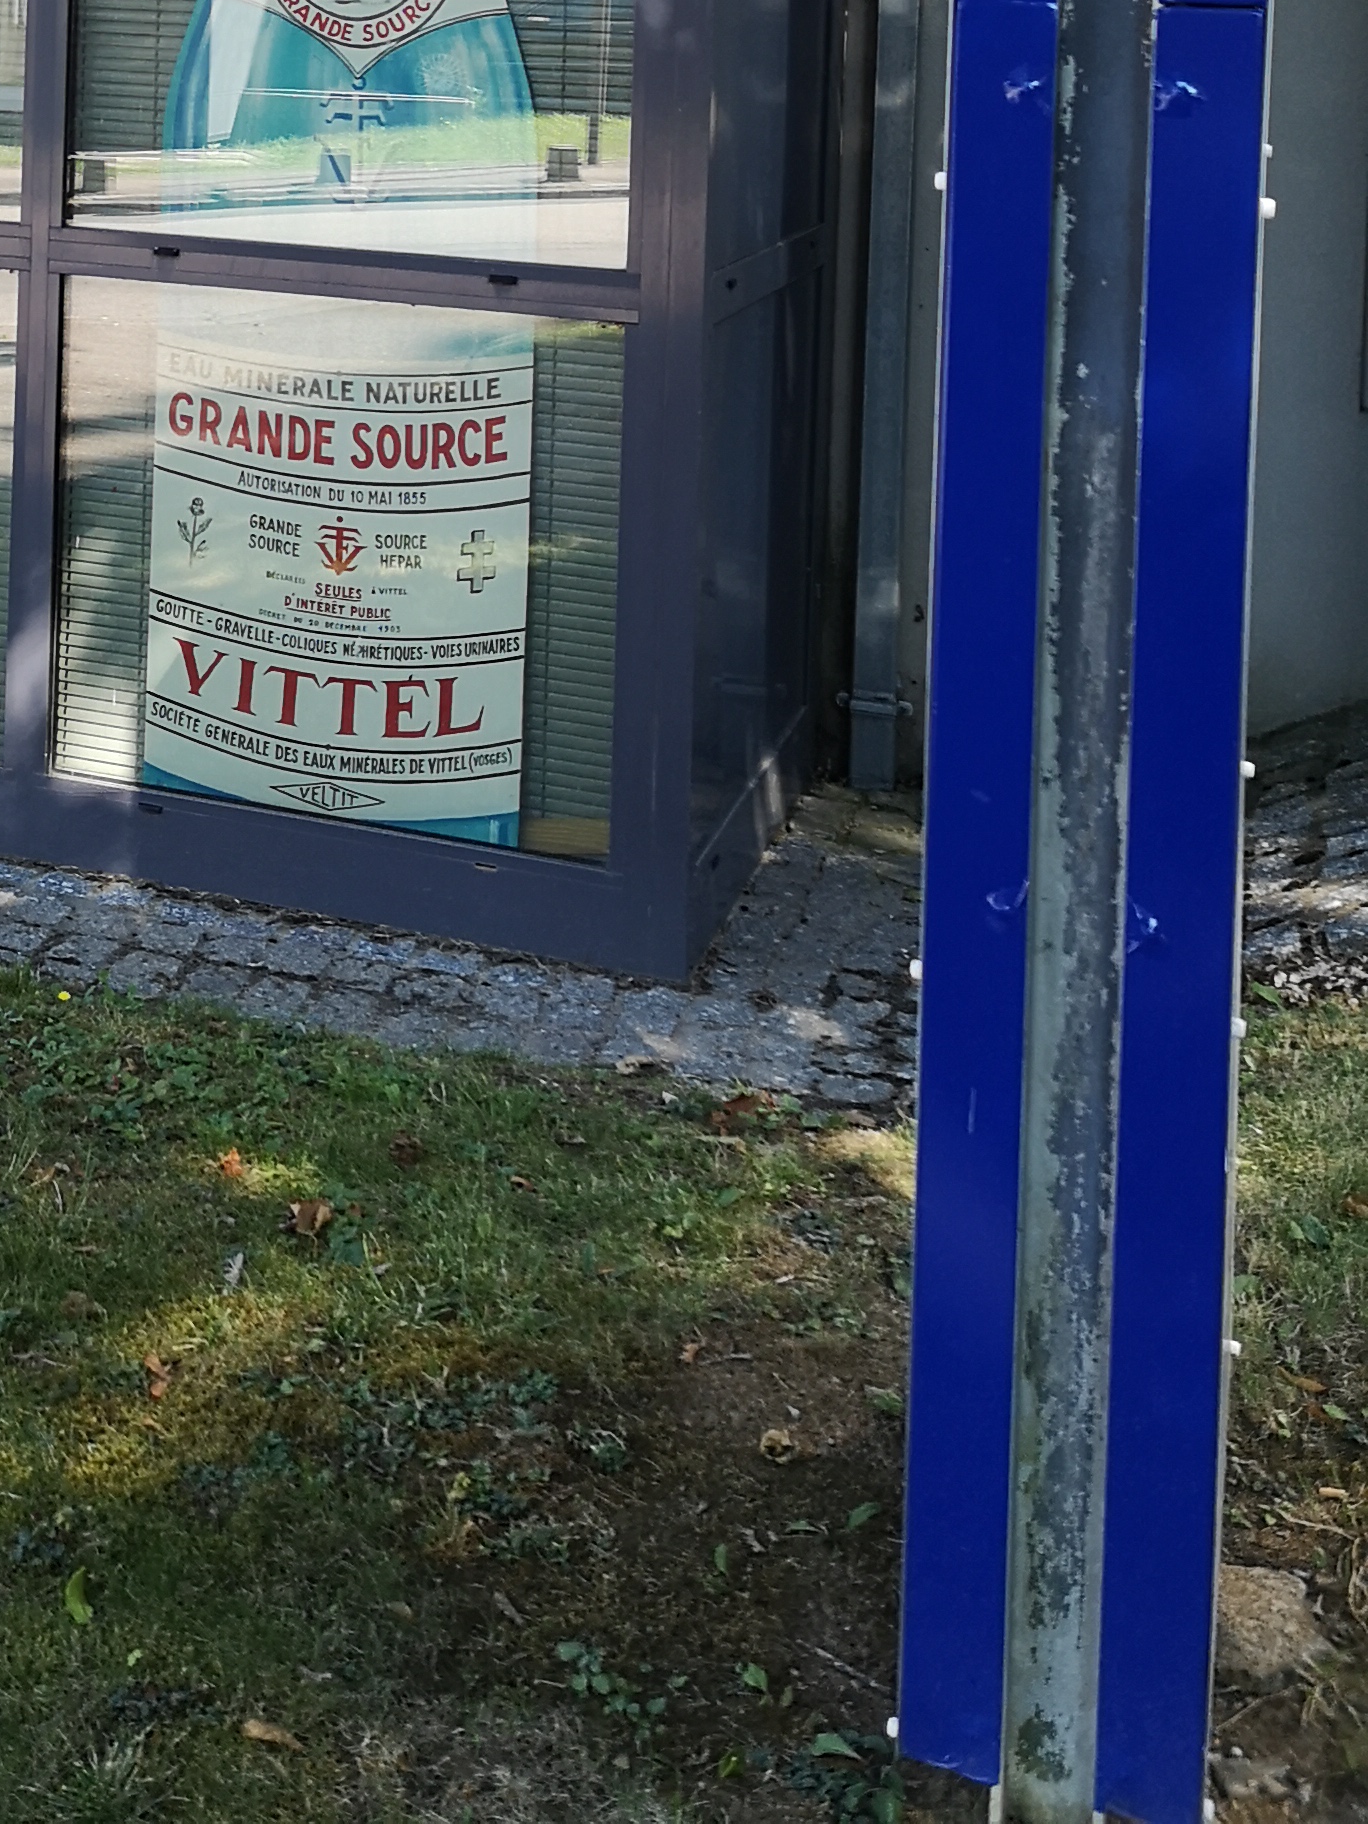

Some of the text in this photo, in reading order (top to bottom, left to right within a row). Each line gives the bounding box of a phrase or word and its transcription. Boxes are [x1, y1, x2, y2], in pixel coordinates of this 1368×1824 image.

[169, 352, 212, 379] EAU
[365, 377, 502, 404] NATURELLE
[168, 391, 508, 470] GRANDE SOURCE
[237, 470, 427, 505] AUTORISATION DU 10 MAI 1855
[249, 513, 303, 538] GRANDE
[248, 533, 301, 558] SOURCE
[374, 534, 428, 550] SOURCE
[314, 582, 363, 600] SEULES
[378, 587, 408, 596] VITTEL
[349, 605, 392, 619] PUBLIC
[431, 644, 462, 659] VOIES
[464, 636, 520, 658] URINAIRES
[274, 743, 299, 764] DES
[303, 750, 336, 771] EAUX
[409, 758, 424, 775] DE
[428, 755, 468, 775] VITTEL
[468, 747, 513, 773] (VOSGES)
[299, 785, 359, 807] VELTIT
